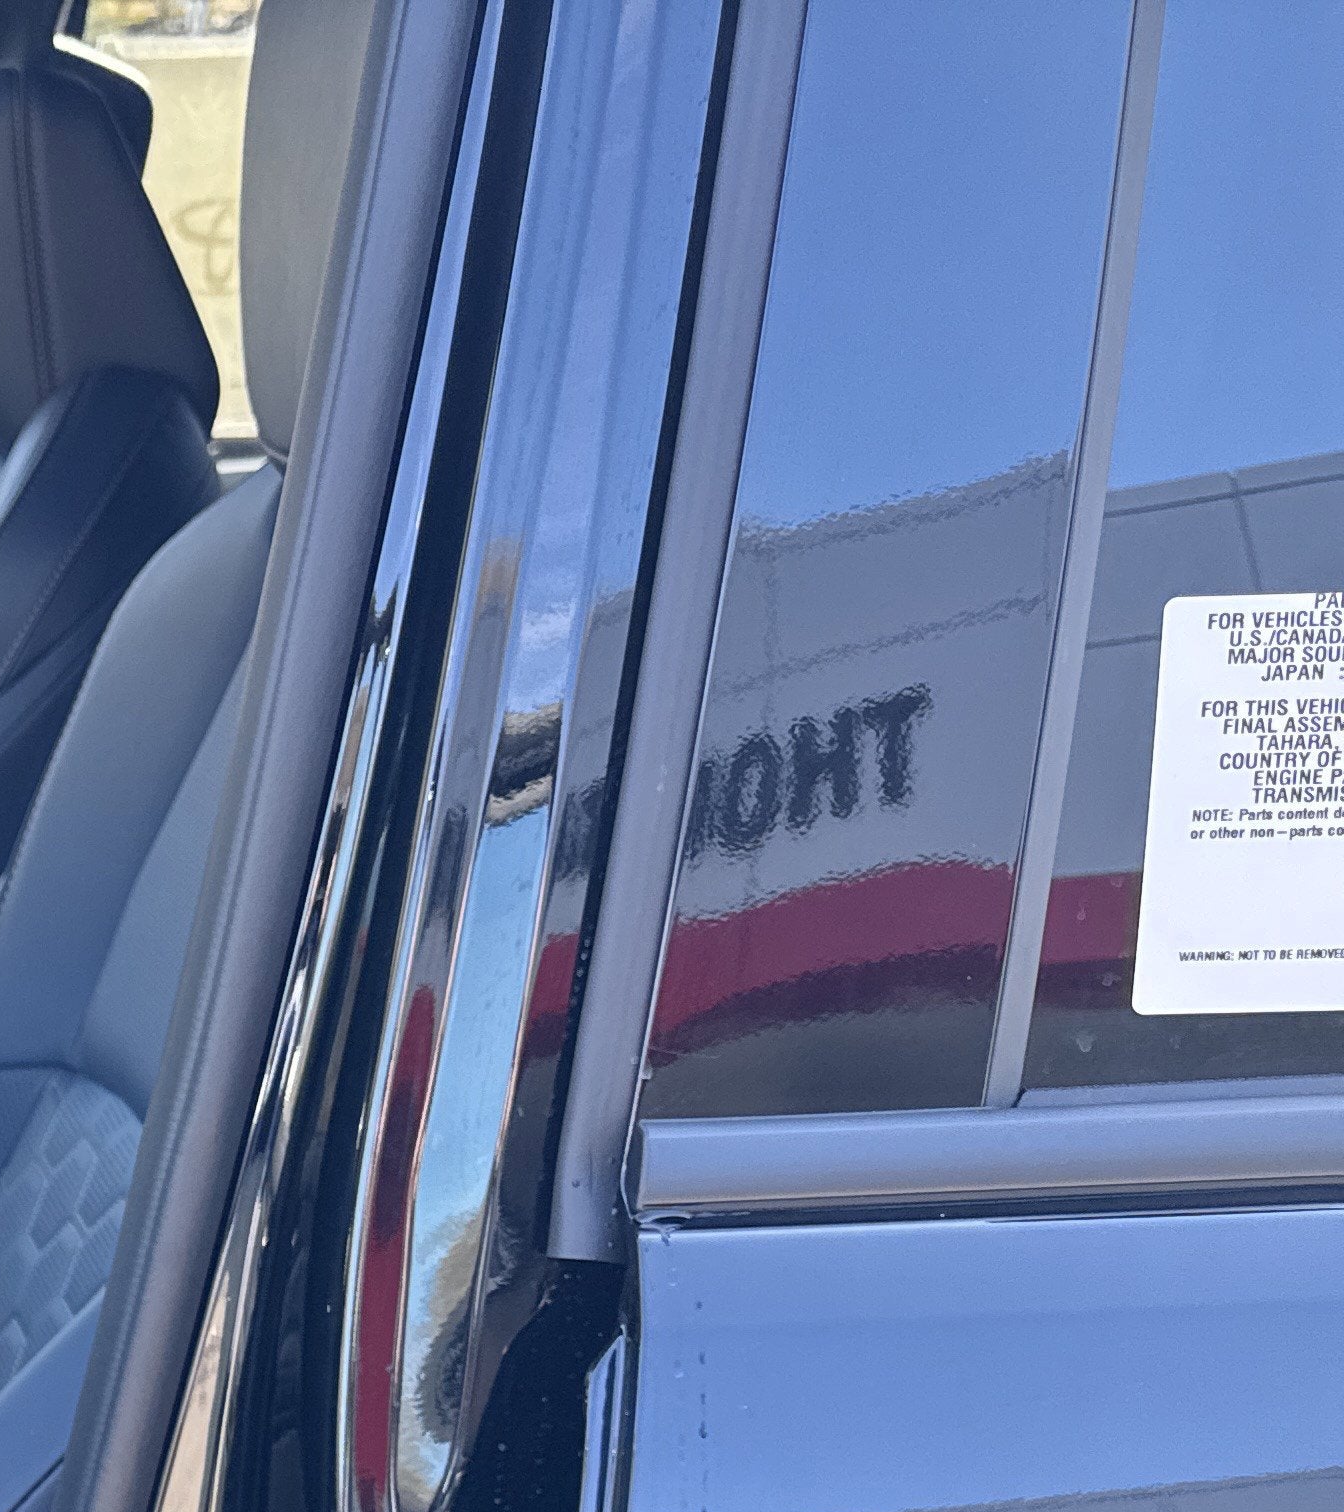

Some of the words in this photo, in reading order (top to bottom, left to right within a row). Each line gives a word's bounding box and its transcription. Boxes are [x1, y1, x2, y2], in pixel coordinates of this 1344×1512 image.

[1314, 592, 1344, 609] PA
[1208, 613, 1245, 629] FOR
[1252, 610, 1343, 628] VEHICLES
[1230, 628, 1344, 647] U.S./CANAD
[1228, 647, 1295, 664] MAJOR
[1302, 646, 1344, 663] SOU
[1261, 664, 1324, 681] JAPAN
[1201, 700, 1238, 717] FOR
[1245, 699, 1288, 716] THIS
[1223, 718, 1277, 734] FINAL
[1256, 734, 1339, 751] TAHARA,
[1220, 752, 1311, 770] COUNTRY
[1318, 751, 1342, 767] OF
[1254, 769, 1323, 786] ENGINE
[1331, 769, 1344, 784] P
[1192, 809, 1233, 822] NOTE:
[1239, 808, 1273, 821] Parts
[1277, 807, 1329, 820] content
[1190, 829, 1205, 839] or
[1210, 827, 1245, 839] other
[1178, 951, 1234, 961] WARNING:
[1238, 950, 1260, 961] NOT
[1263, 950, 1276, 960] TO
[1279, 950, 1292, 960] BE
